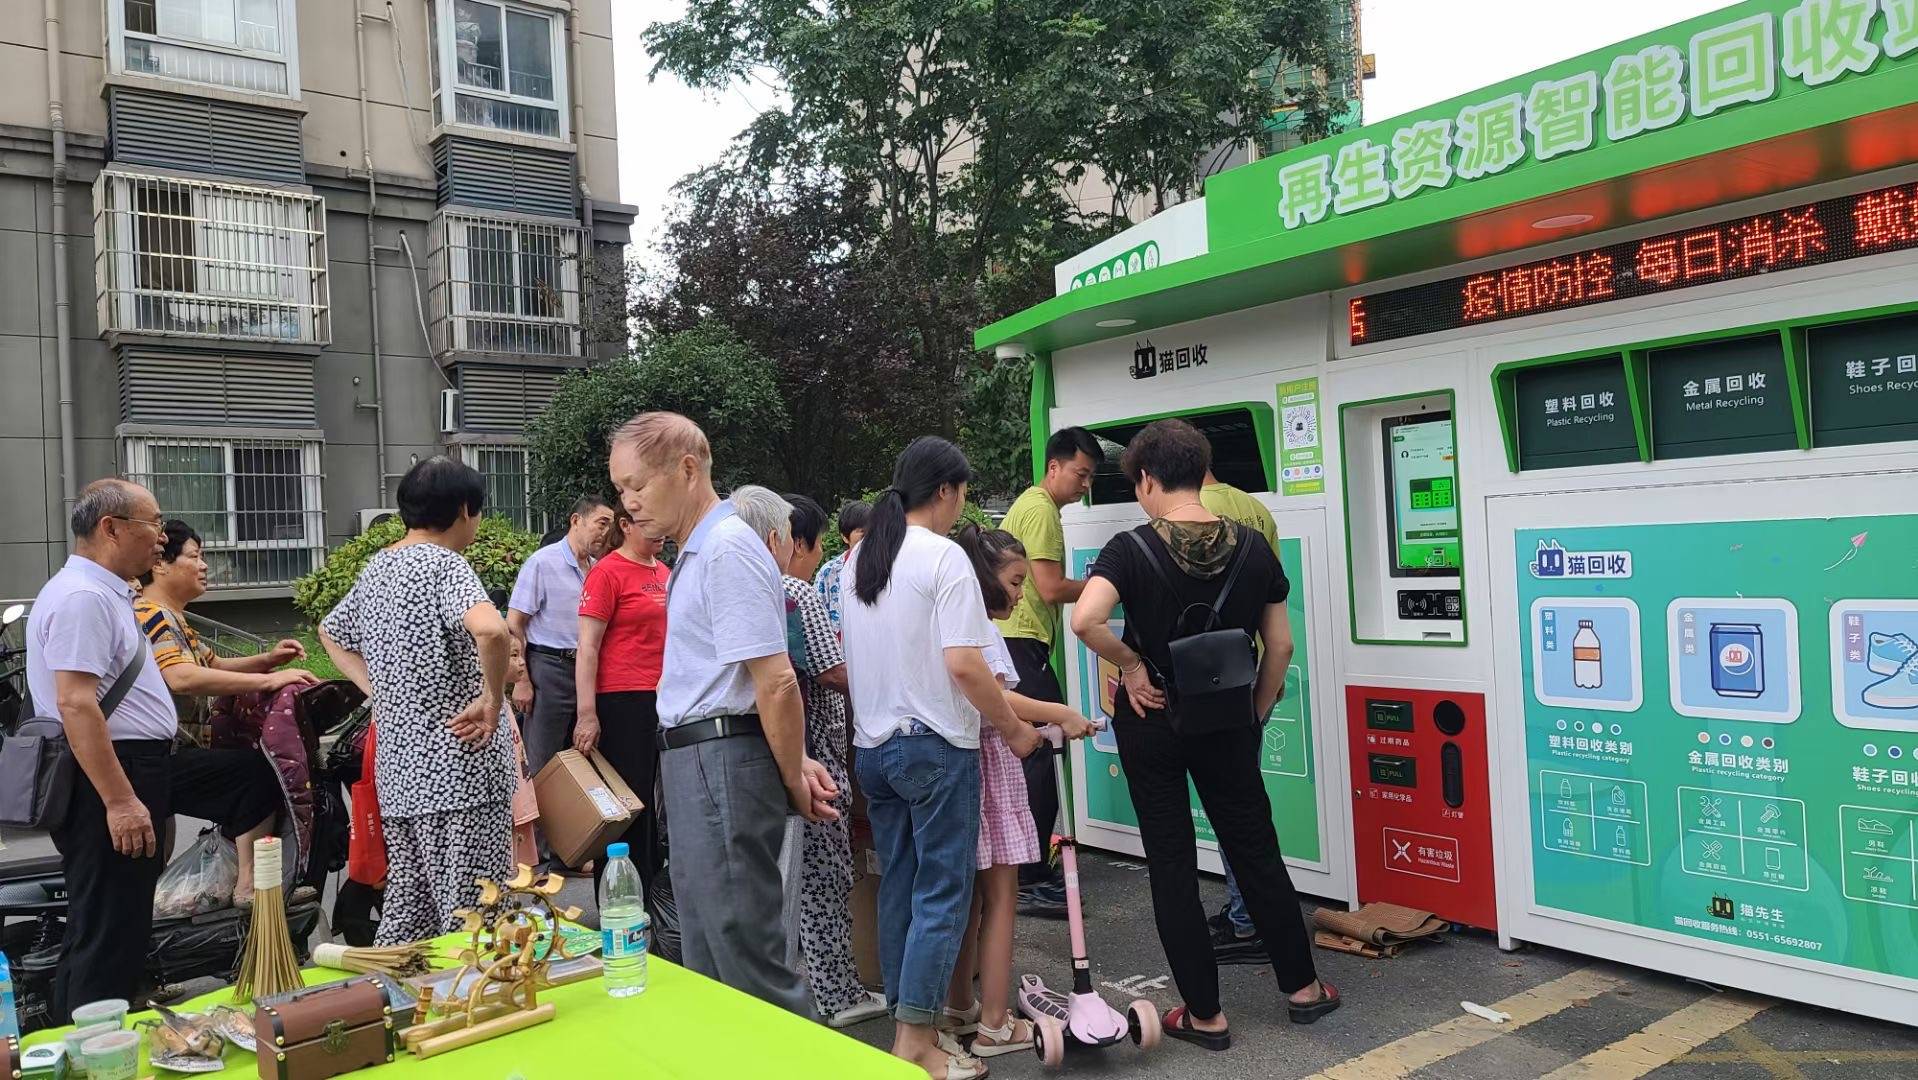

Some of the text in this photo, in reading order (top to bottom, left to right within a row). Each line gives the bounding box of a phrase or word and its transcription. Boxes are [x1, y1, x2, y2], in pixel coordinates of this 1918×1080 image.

[1461, 251, 1615, 321] 疫情防控
[1635, 208, 1829, 285] 每日消杀
[1159, 343, 1208, 374] 猫回收
[1846, 354, 1917, 379] 鞋子回
[1683, 372, 1767, 397] 金属回收
[1849, 384, 1884, 395] Shoes
[1545, 391, 1615, 414] 塑料回收
[1686, 395, 1765, 412] Metal Recycling
[1547, 412, 1615, 427] Plastic Recycling
[1568, 554, 1626, 575] 猫回收
[1683, 612, 1695, 654] 金属类
[1848, 615, 1861, 661] 鞋子类
[1380, 736, 1410, 747] 过期药品
[1549, 735, 1633, 756] 塑料回收类别
[1552, 749, 1630, 765] Plastic recycling category
[1688, 750, 1789, 774] 金属回收类别
[1692, 766, 1786, 783] Plastic recycling category
[1856, 783, 1918, 798] Shoes recycling
[1417, 846, 1453, 861] 有害垃圾
[1740, 903, 1785, 923] 猫先生
[1746, 929, 1823, 951] 0551-65692807
